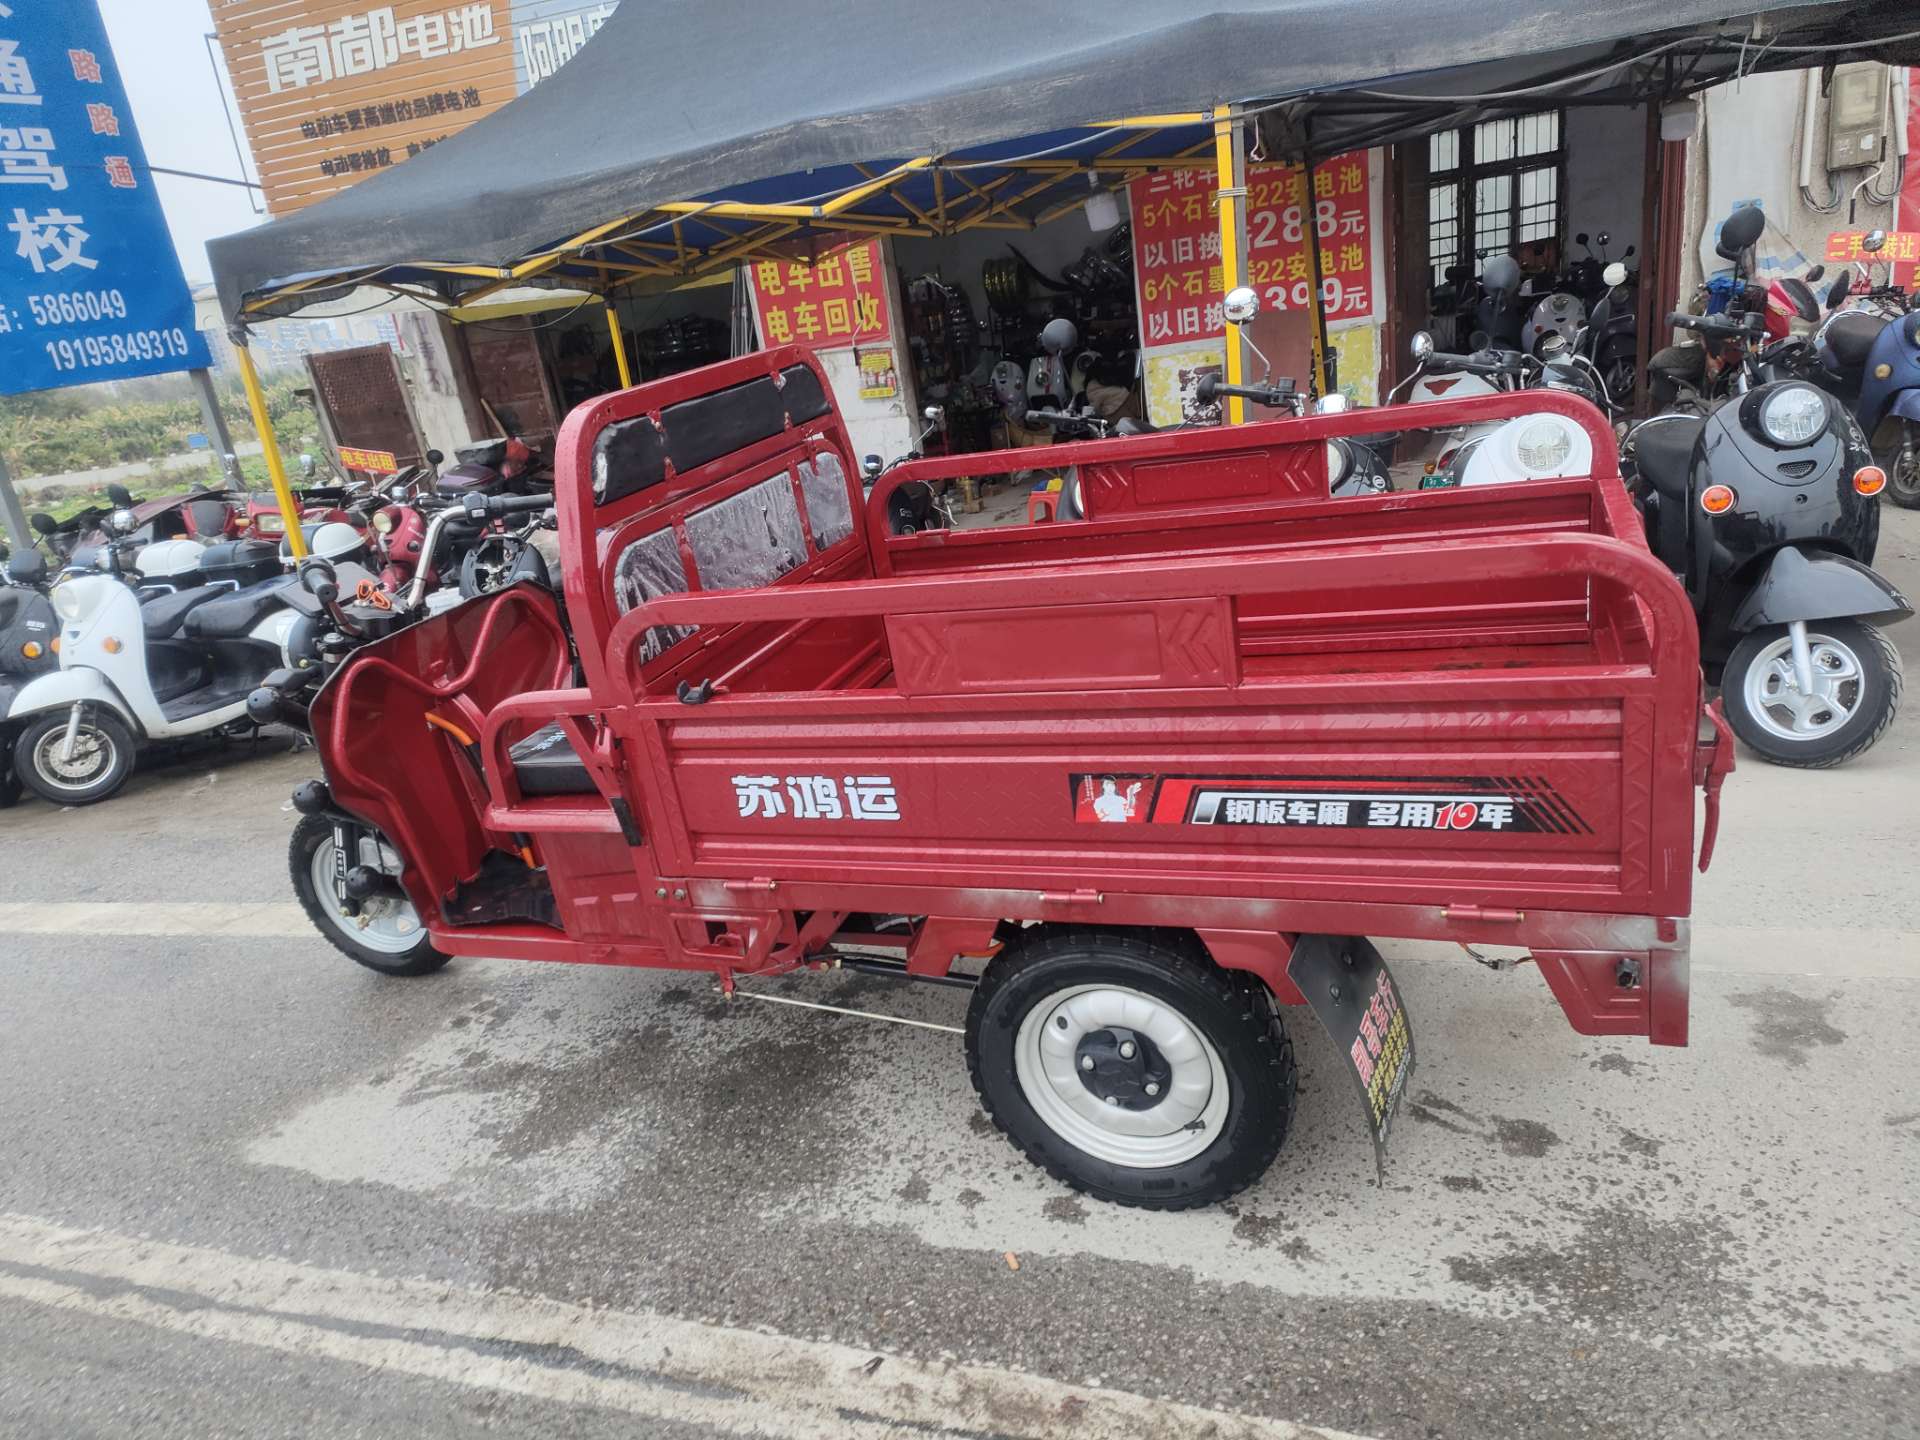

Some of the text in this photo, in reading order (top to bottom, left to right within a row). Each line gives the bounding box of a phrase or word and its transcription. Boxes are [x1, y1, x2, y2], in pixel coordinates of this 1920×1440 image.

[261, 5, 500, 93] 南都电池
[521, 3, 616, 89] 阿明
[68, 48, 136, 188] 路路通
[1143, 200, 1366, 269] 以旧换288元
[1830, 234, 1915, 259] 二手转让
[757, 245, 872, 296] 电车出售
[766, 292, 882, 343] 电车回收
[1148, 277, 1368, 340] 以旧换399元
[46, 327, 188, 371] 19195849319
[340, 450, 395, 471] 电车出租
[731, 775, 901, 820] 苏鸿运
[1225, 799, 1514, 830] 钢板车厢 多用10年
